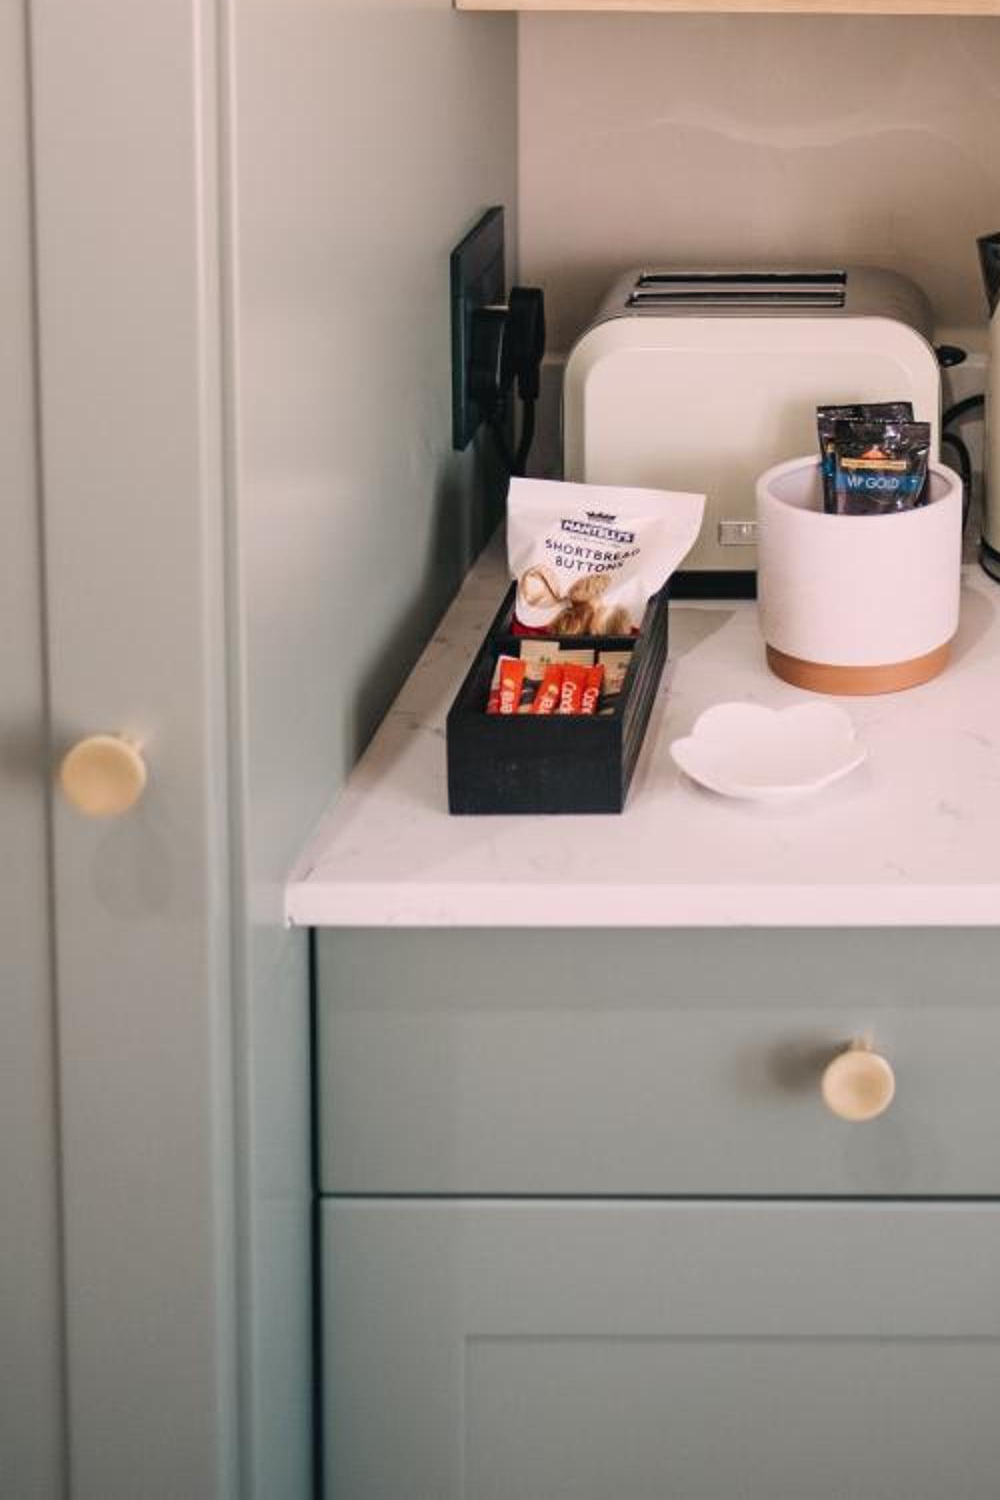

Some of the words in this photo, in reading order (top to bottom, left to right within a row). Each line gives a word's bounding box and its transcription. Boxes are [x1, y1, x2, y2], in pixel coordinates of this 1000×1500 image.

[865, 477, 899, 489] GOLD
[545, 538, 641, 561] SHORTBREAD
[555, 555, 623, 573] BUTTONS
